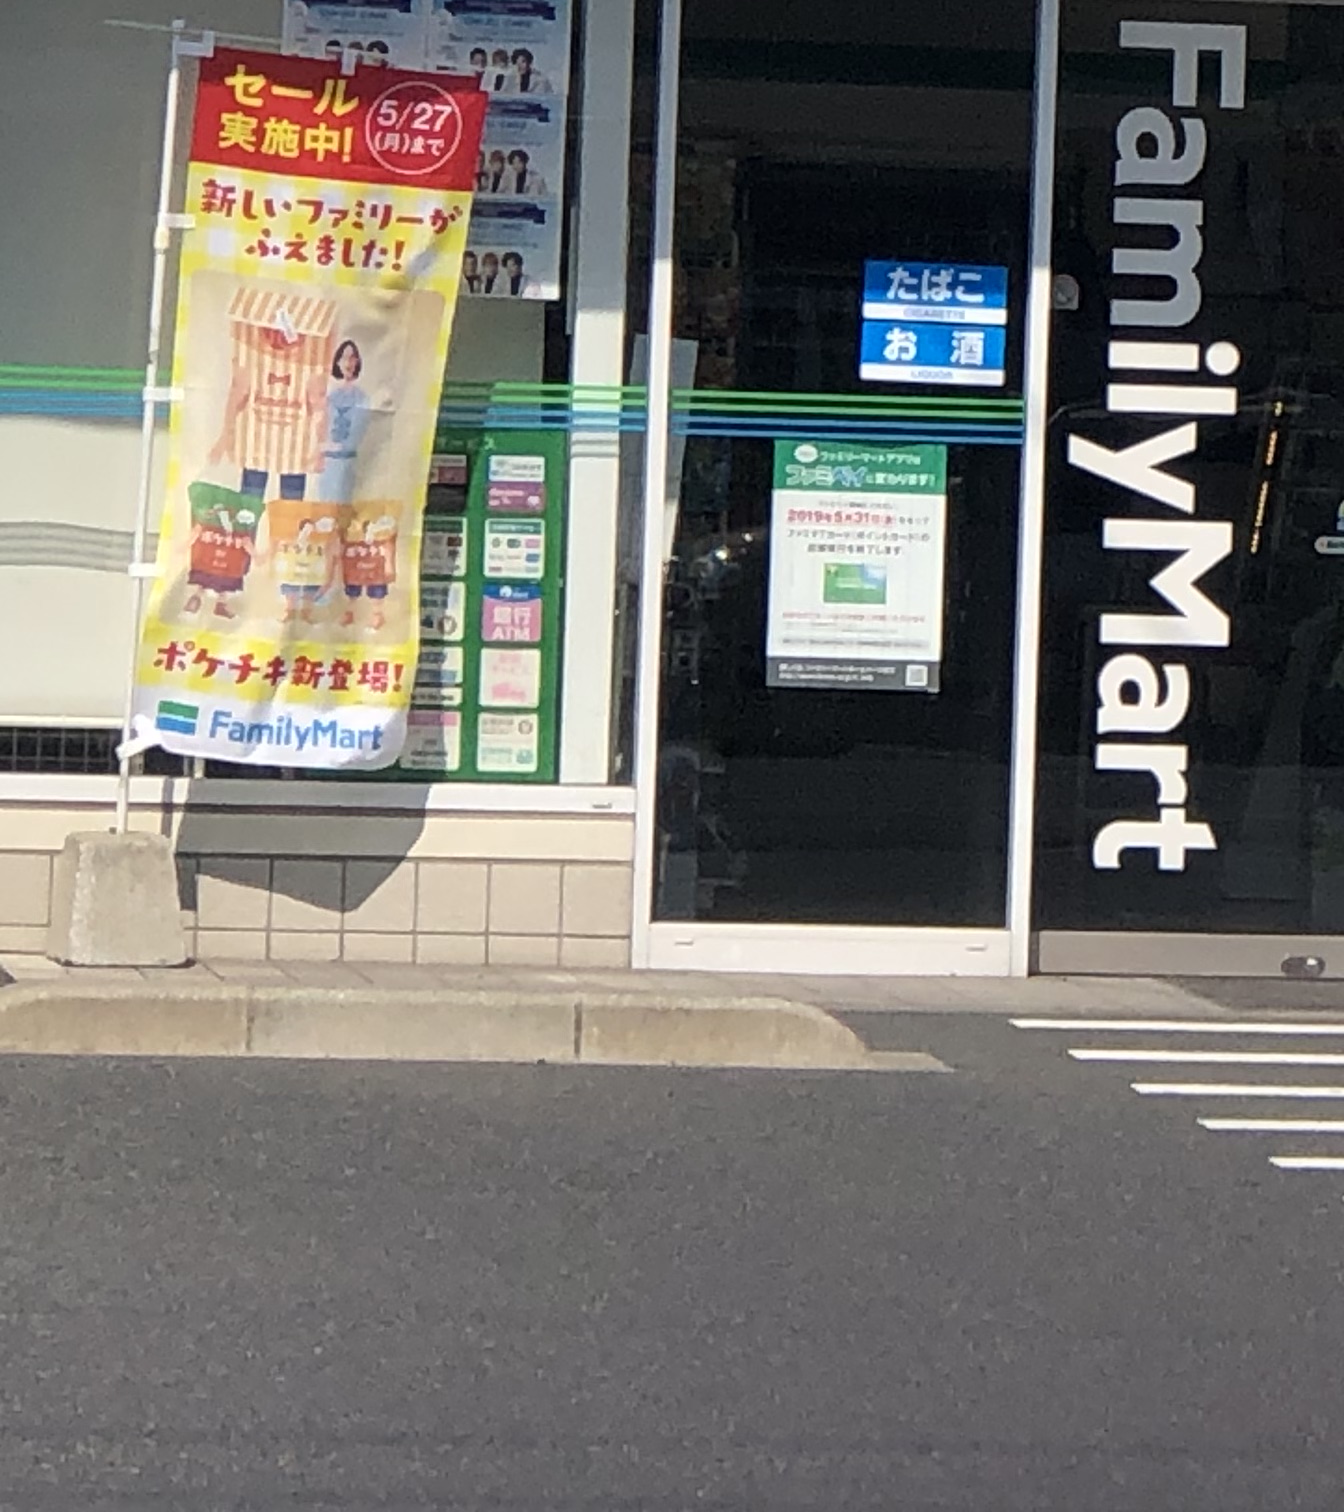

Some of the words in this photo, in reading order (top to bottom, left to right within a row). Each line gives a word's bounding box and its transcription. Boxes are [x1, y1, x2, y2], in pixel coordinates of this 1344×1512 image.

[225, 64, 359, 117] セール
[218, 111, 354, 163] 実施中!
[376, 99, 453, 132] 5/27
[374, 132, 445, 156] (月)まで
[200, 178, 463, 235] 新しいファミリーが
[244, 228, 406, 272] ふえました!
[886, 266, 985, 303] たばこ
[1067, 19, 1248, 872] FamilyMart
[491, 627, 531, 640] ATM
[153, 641, 405, 693] ポケチキ新登場!
[208, 709, 384, 751] FamilyMart
